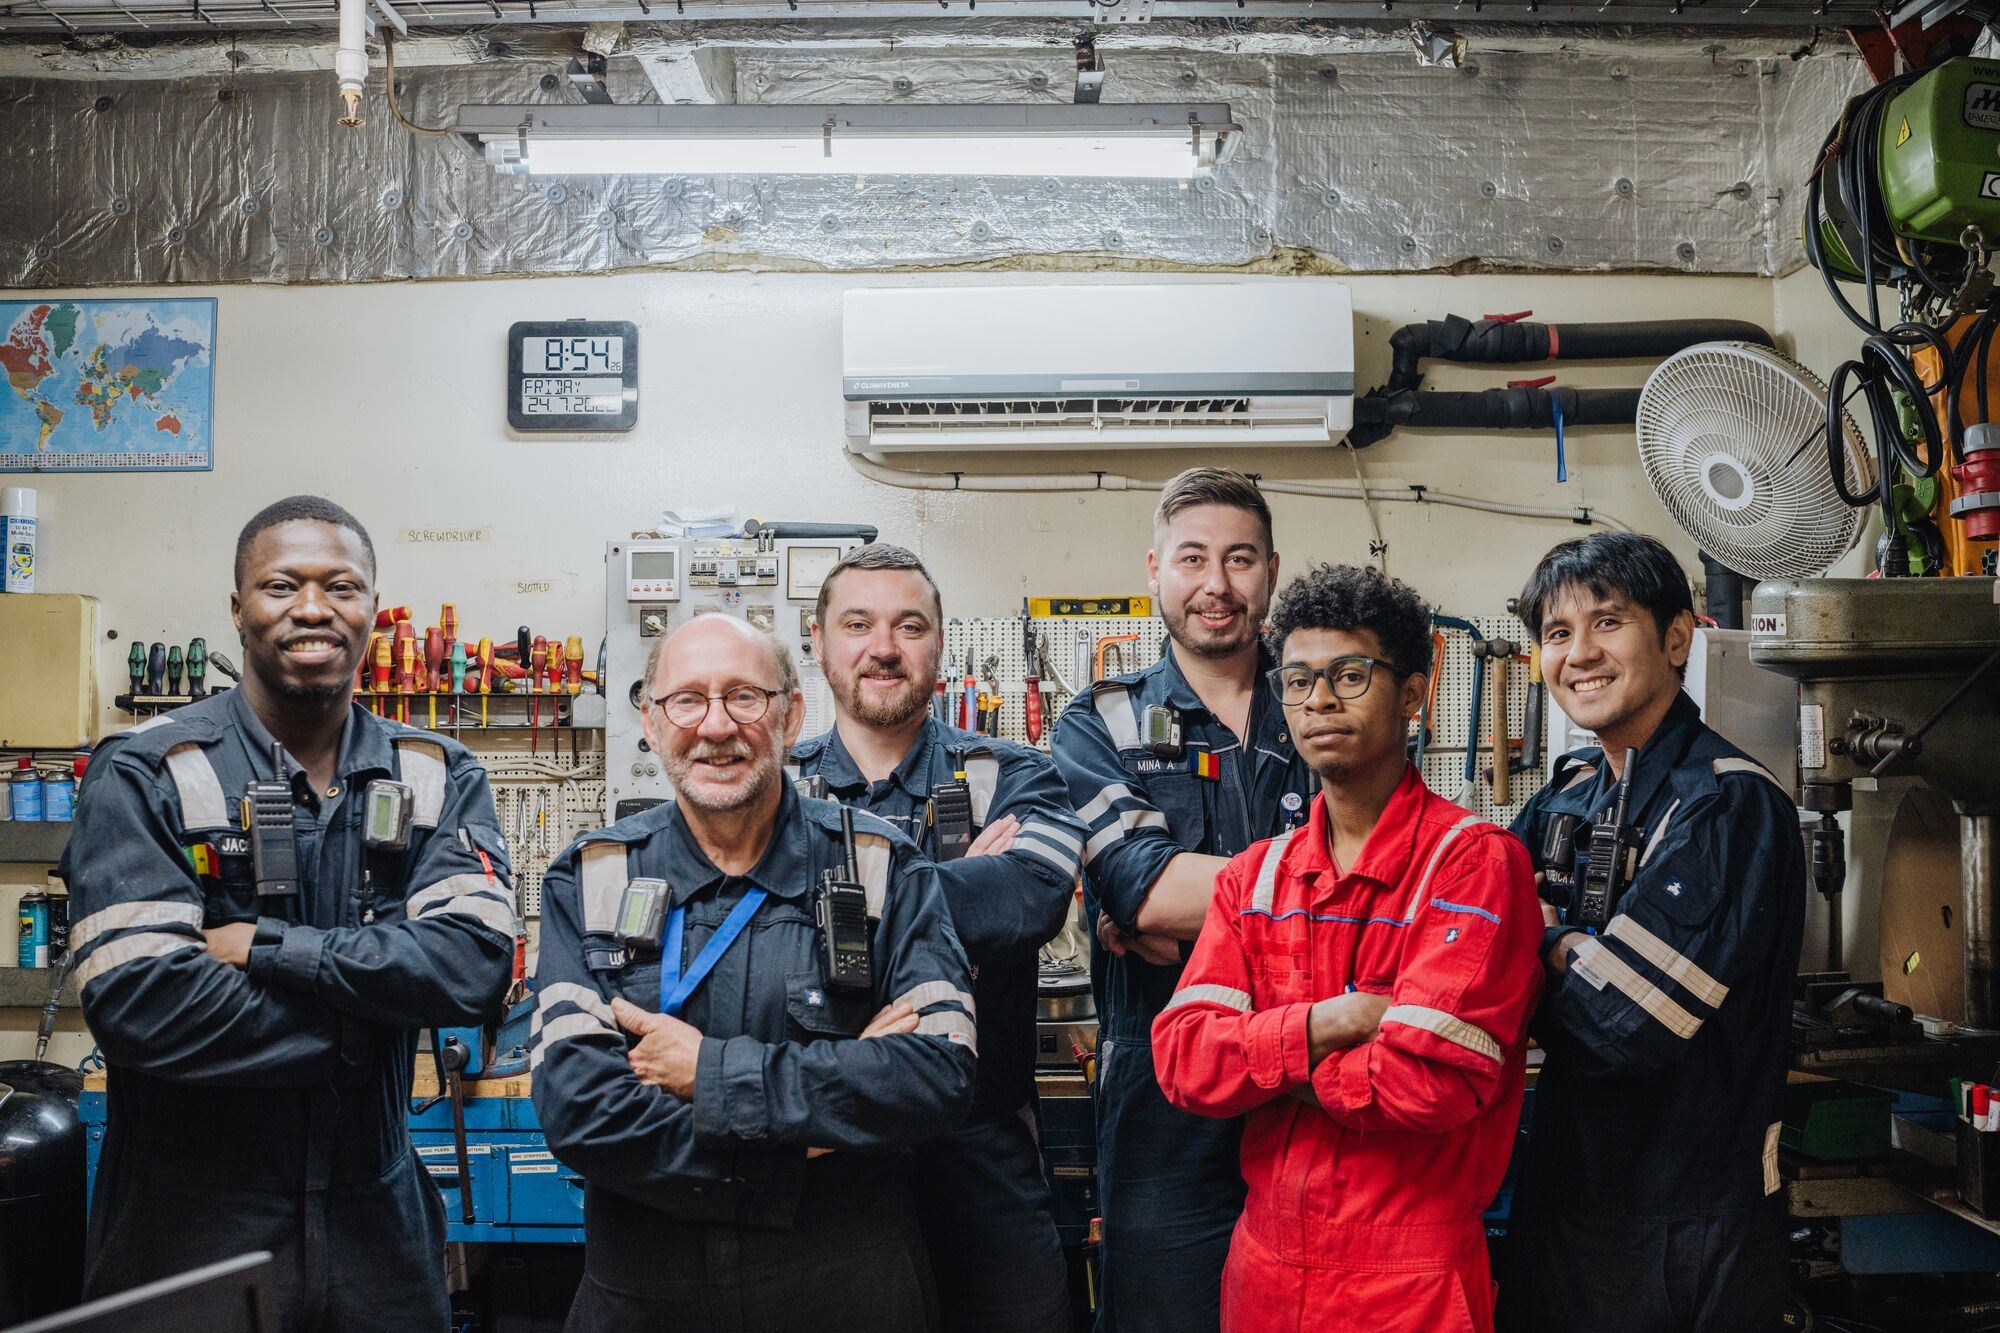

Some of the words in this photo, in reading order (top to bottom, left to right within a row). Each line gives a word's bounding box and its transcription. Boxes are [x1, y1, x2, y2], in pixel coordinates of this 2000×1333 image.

[545, 338, 609, 371] 8:54
[610, 361, 622, 371] 26
[524, 379, 581, 395] FRIDAY
[558, 397, 617, 413] 7.20
[408, 530, 482, 543] SCREWDRIVER
[517, 582, 550, 594] SLOTTED
[1137, 758, 1161, 772] MINA
[1166, 762, 1175, 771] A
[221, 837, 249, 853] JAC
